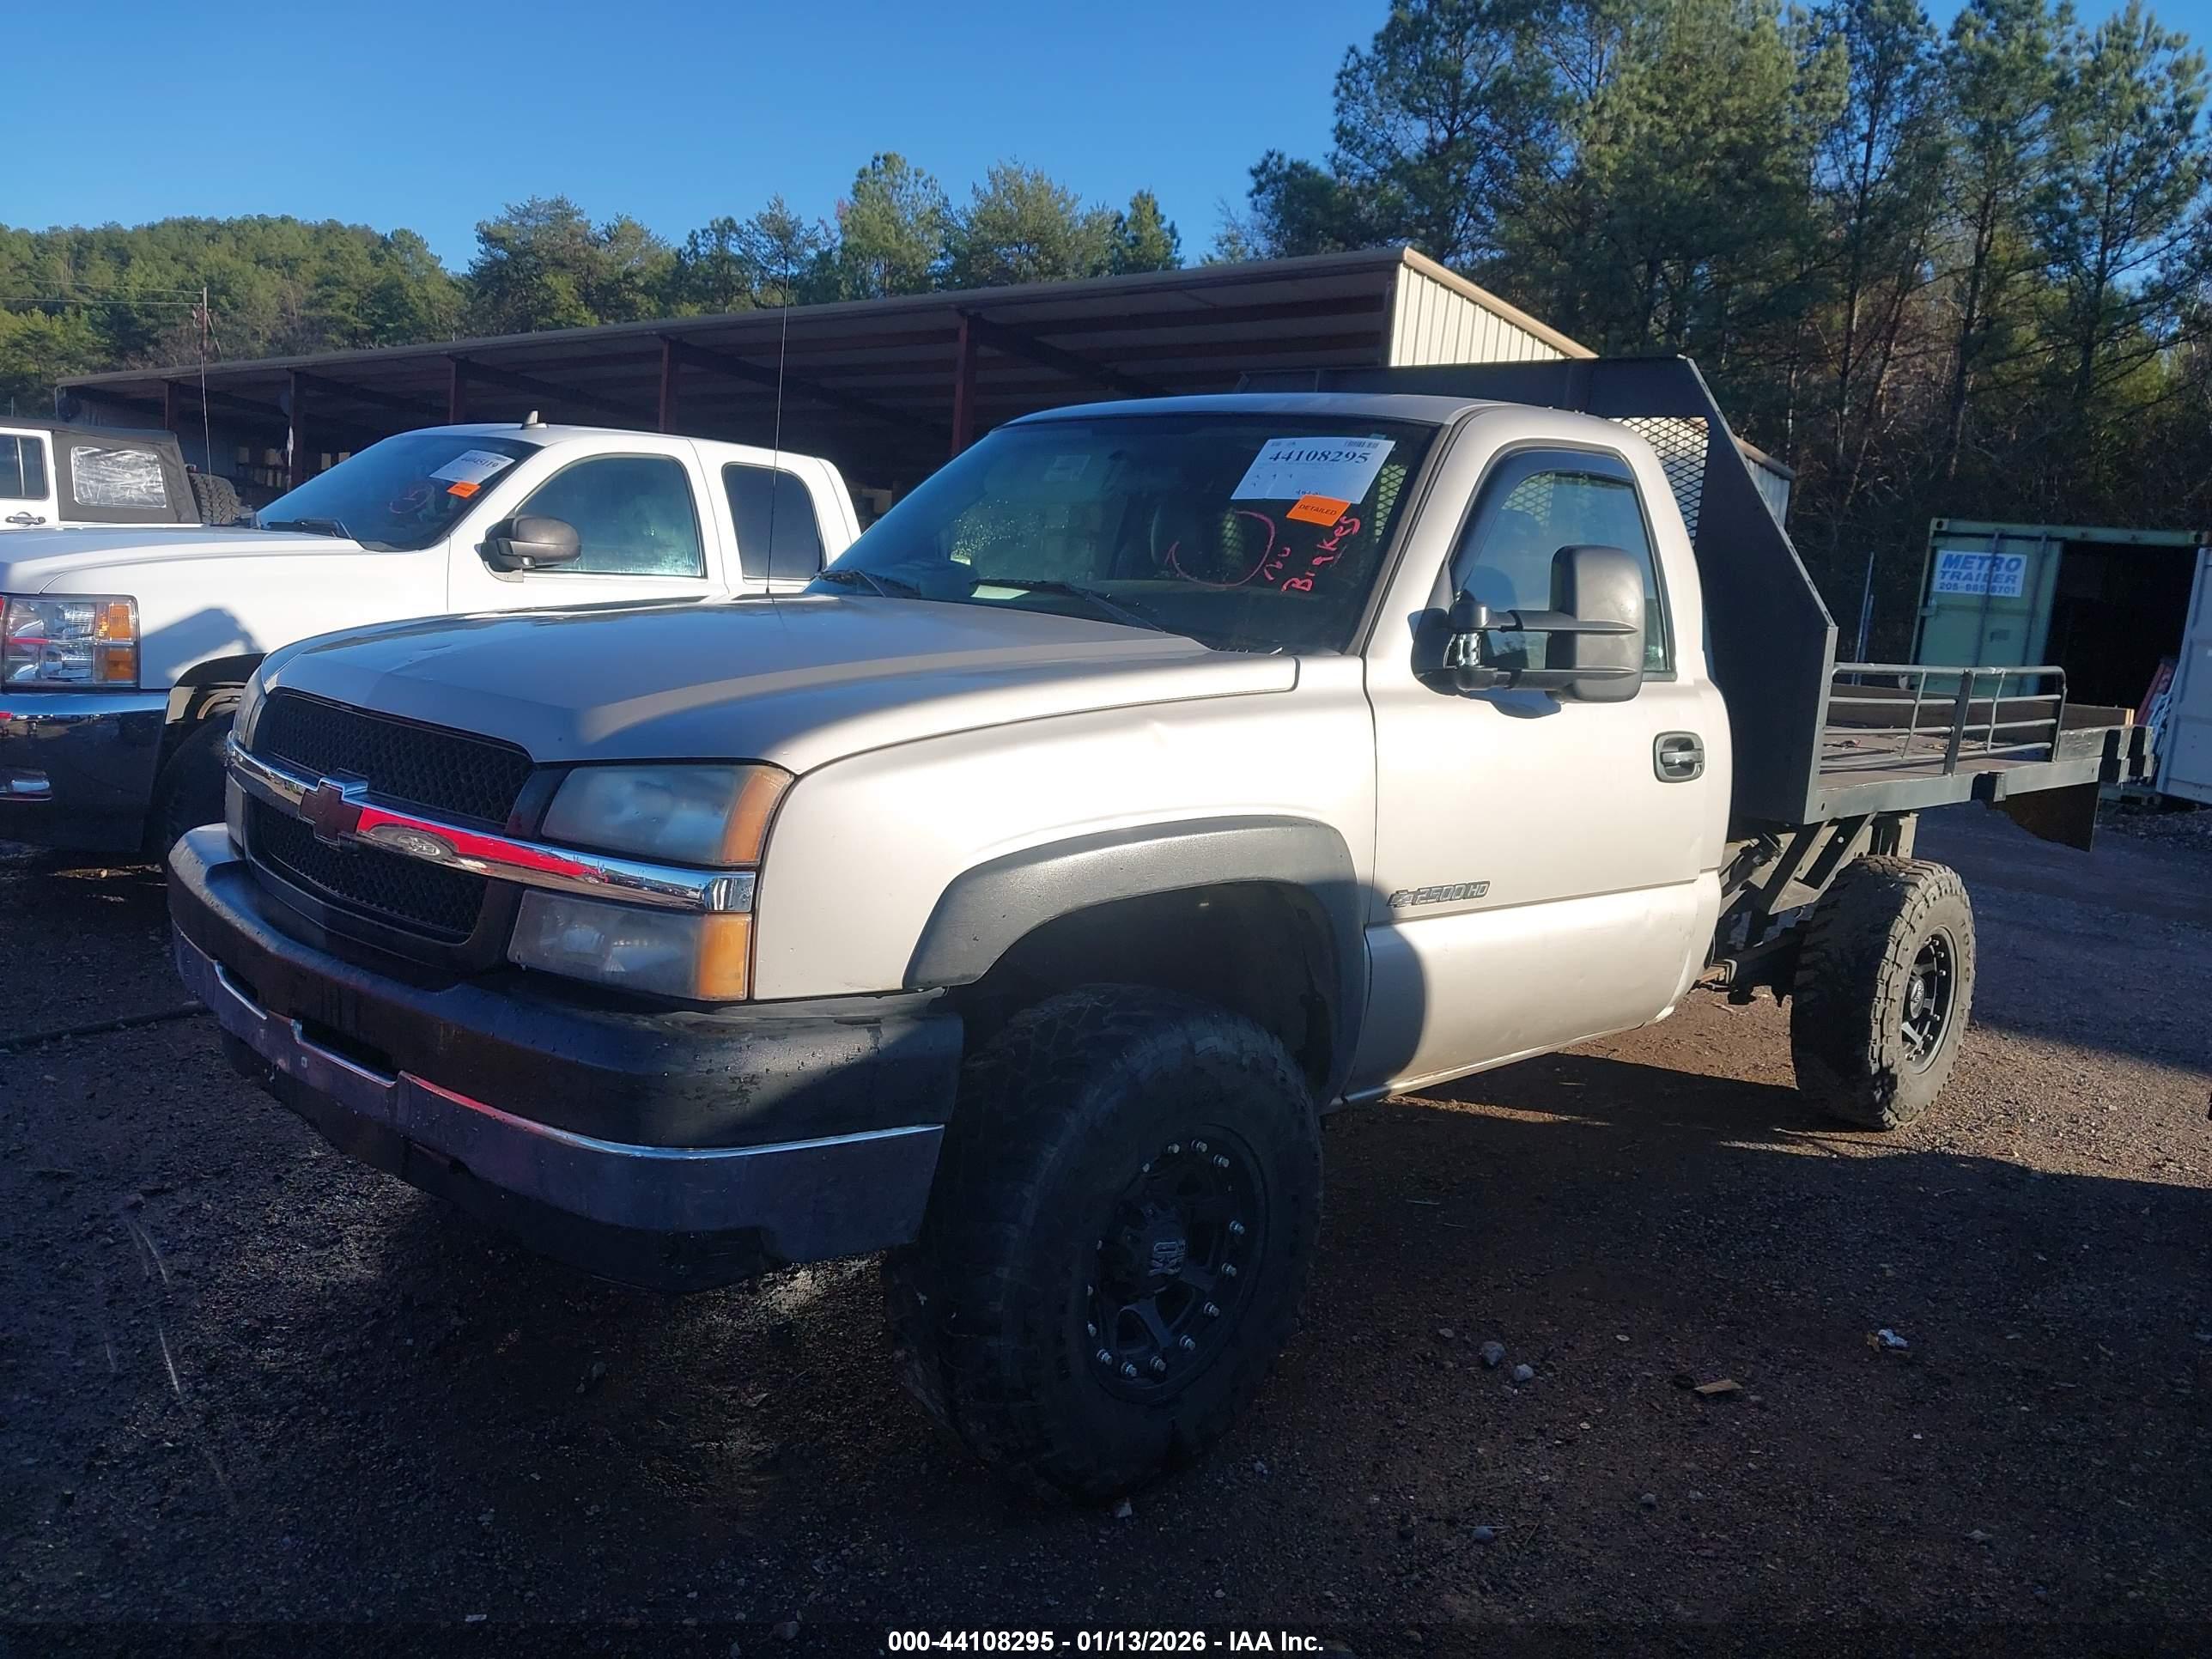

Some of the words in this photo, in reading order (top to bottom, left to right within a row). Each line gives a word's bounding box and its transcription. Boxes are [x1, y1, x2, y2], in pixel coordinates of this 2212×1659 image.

[1268, 449, 1371, 465] 44108295
[1297, 503, 1337, 516] DETAILED
[1942, 553, 2022, 573] METRO
[1939, 569, 2017, 584] TRAILER
[1414, 884, 1467, 905] 2500
[1468, 882, 1490, 897] HD
